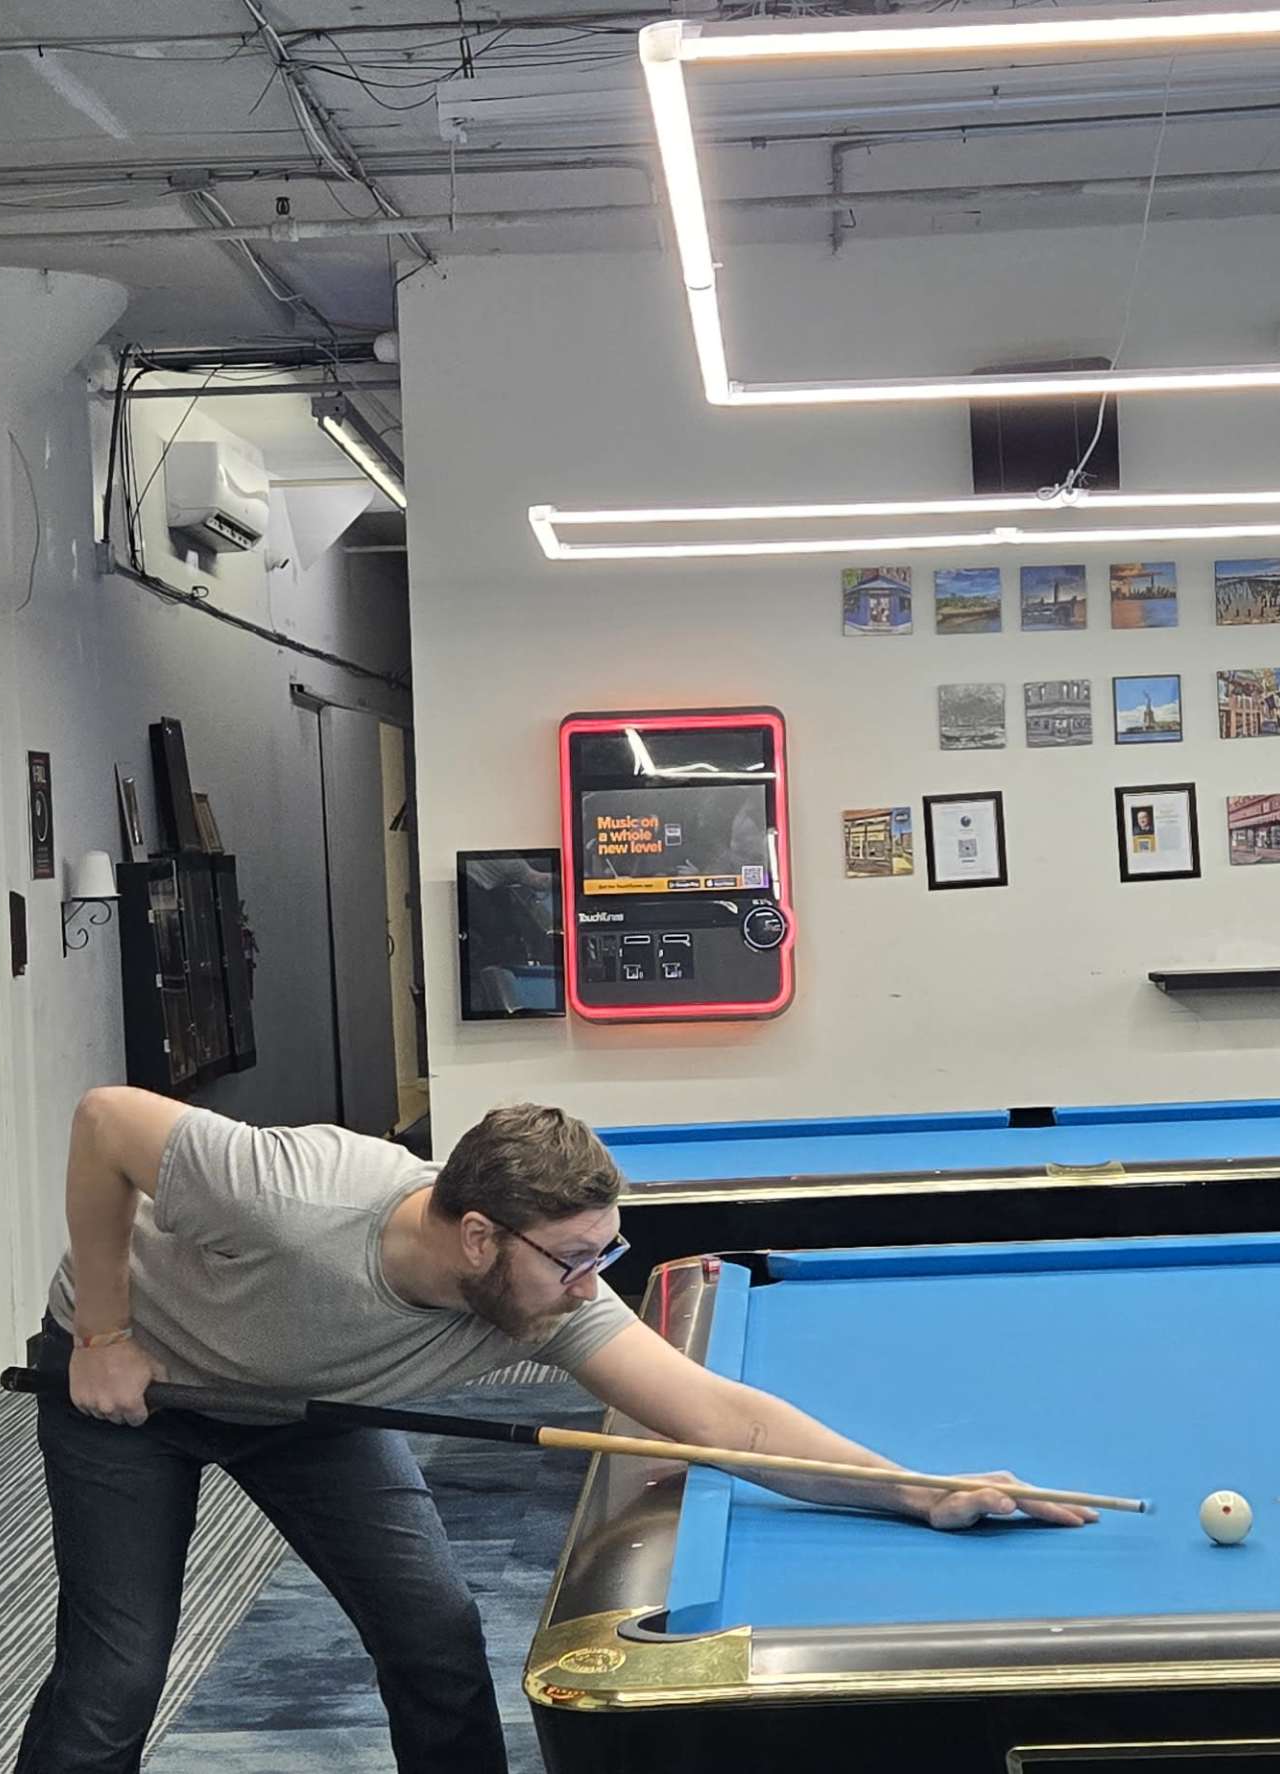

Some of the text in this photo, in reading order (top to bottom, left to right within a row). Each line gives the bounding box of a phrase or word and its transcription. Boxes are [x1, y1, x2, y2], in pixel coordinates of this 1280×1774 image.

[597, 815, 659, 829] Music on
[598, 829, 652, 842] a whole
[598, 839, 662, 855] new level
